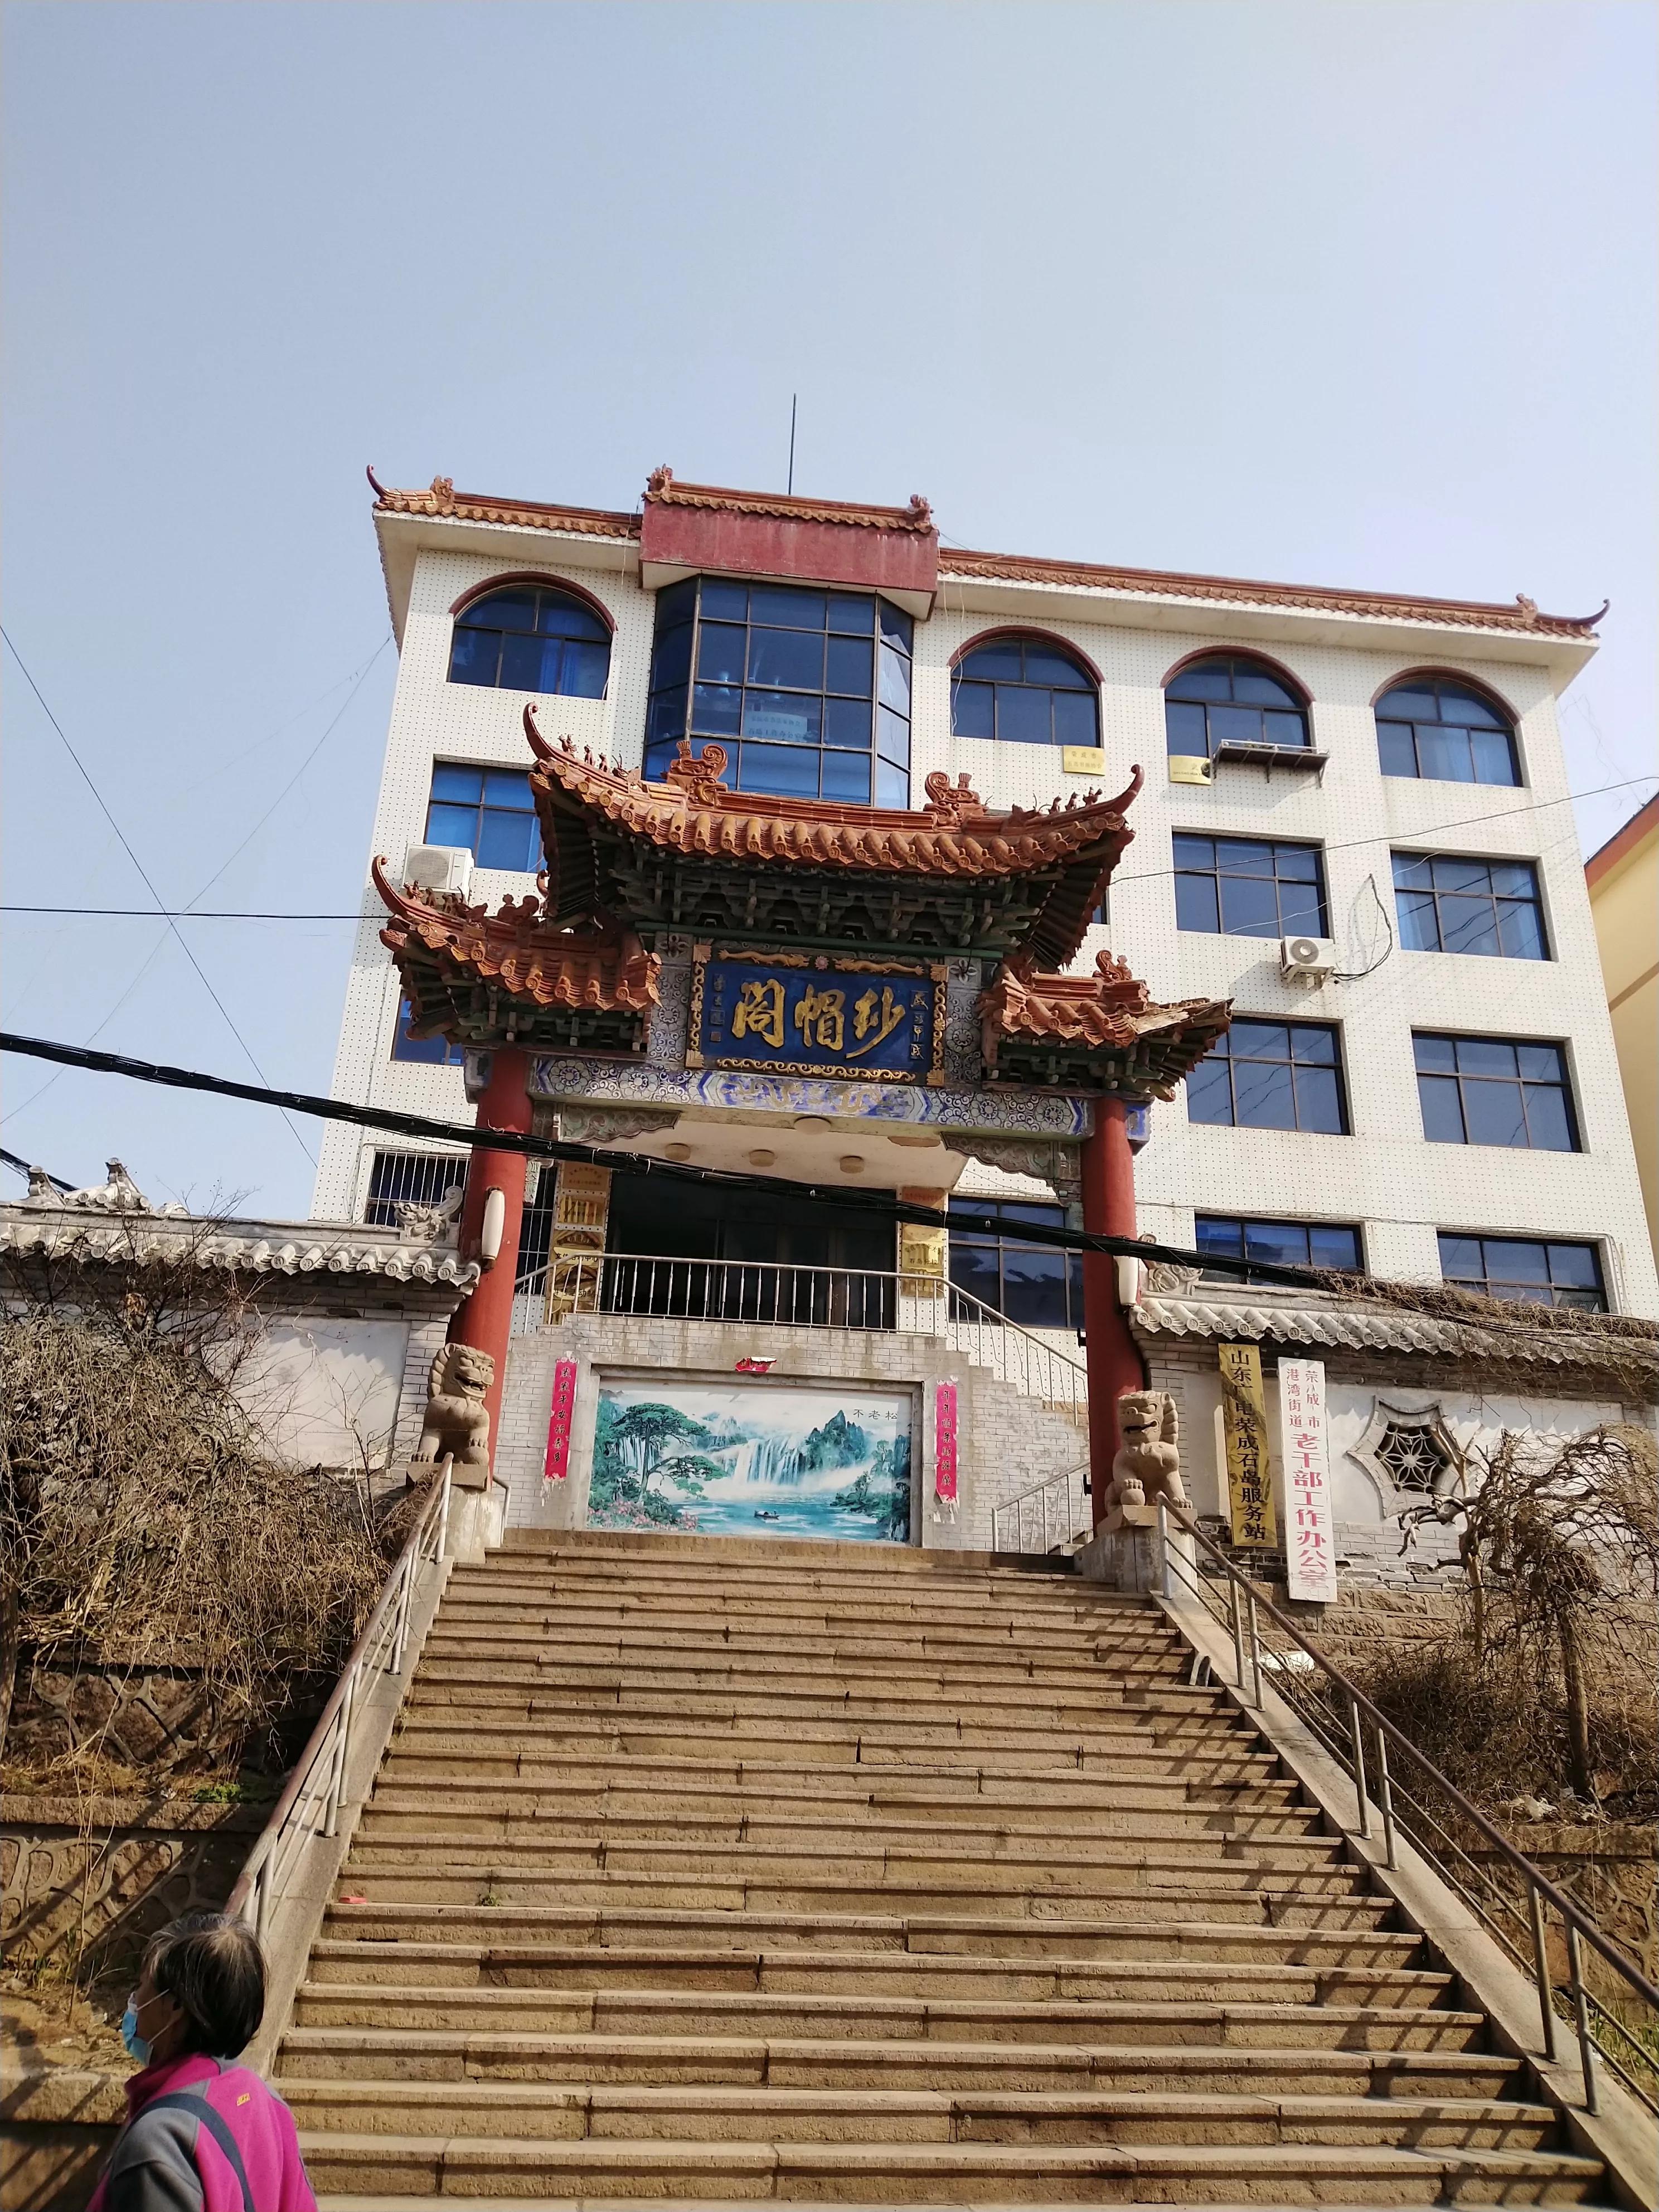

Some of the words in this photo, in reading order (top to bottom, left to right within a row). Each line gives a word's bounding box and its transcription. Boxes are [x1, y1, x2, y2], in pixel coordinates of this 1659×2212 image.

[853, 1409, 898, 1421] 不老松
[1286, 1368, 1303, 1428] 港湾街道
[1306, 1370, 1321, 1428] 荣成市
[1231, 1350, 1266, 1541] 山东广电荣成石岛服务站
[1291, 1433, 1328, 1589] 老干部工作办公室
